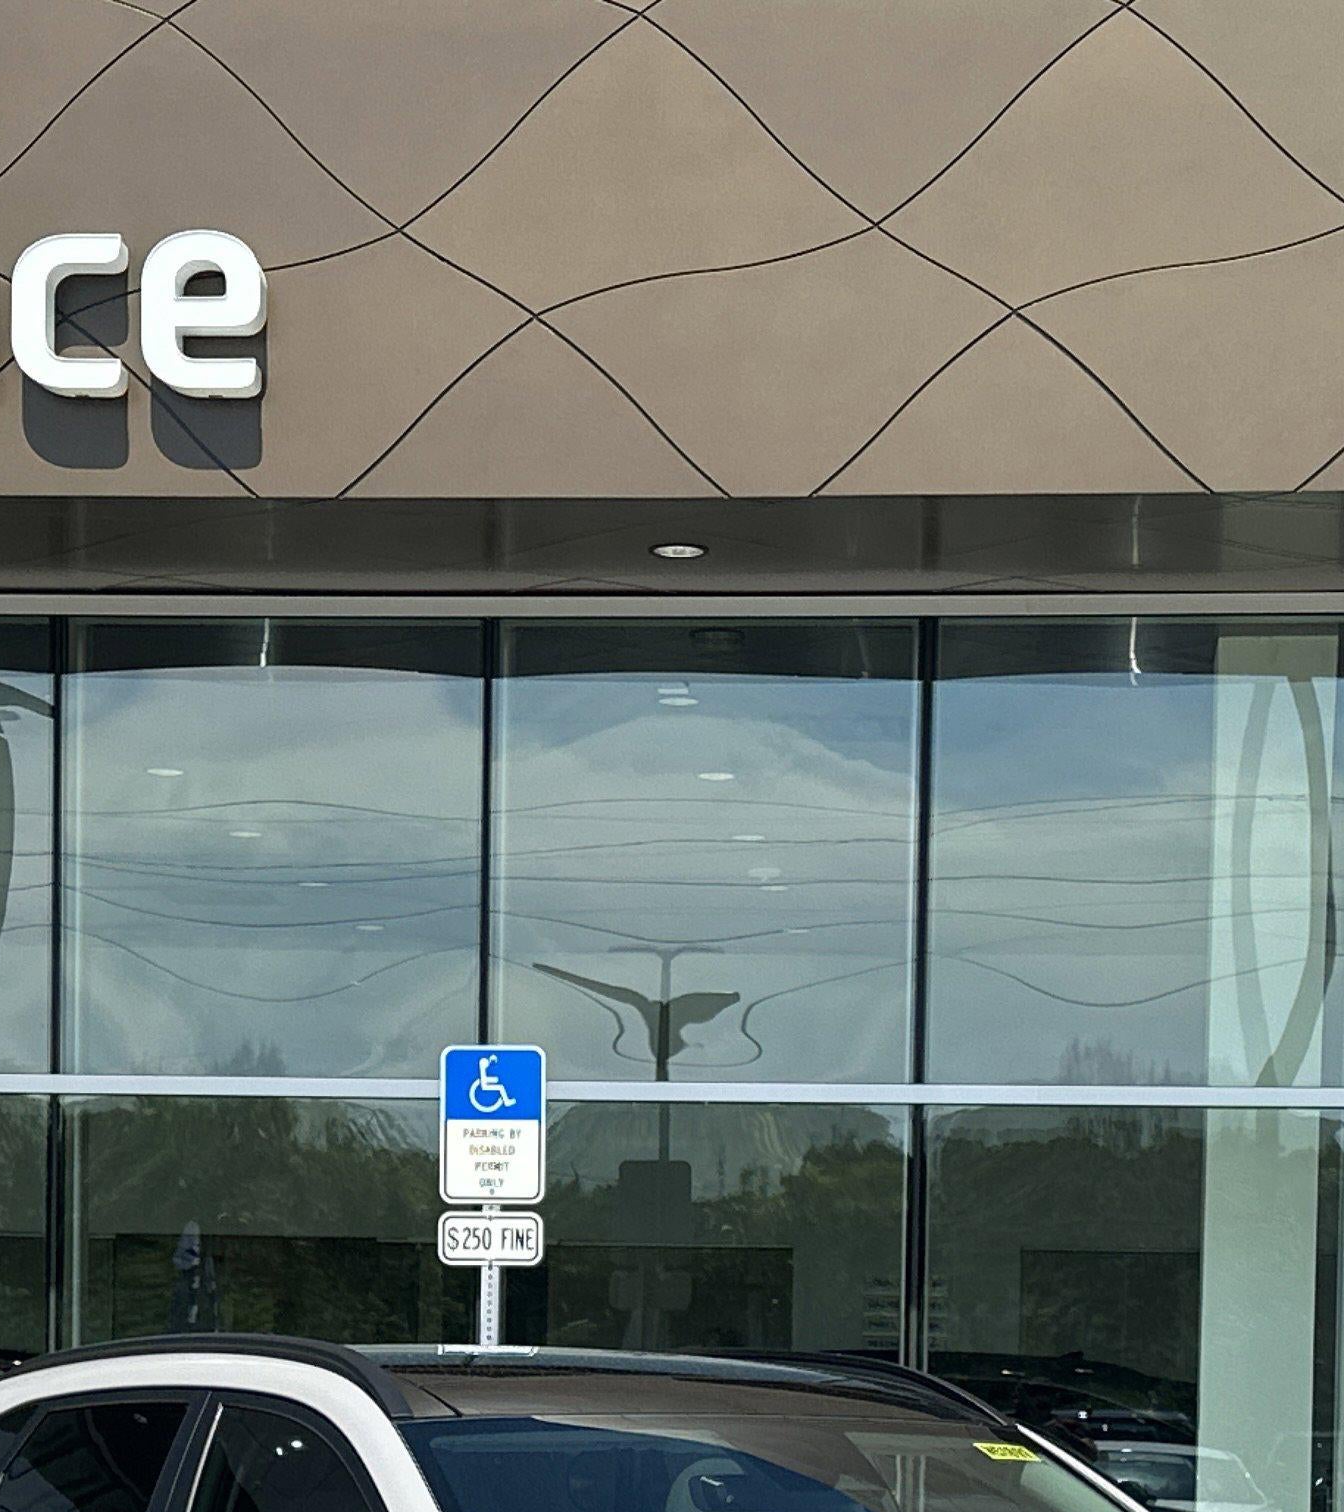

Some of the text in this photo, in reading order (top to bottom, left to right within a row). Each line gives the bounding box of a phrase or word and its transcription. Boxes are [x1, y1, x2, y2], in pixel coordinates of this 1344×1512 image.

[509, 1127, 522, 1139] BY
[447, 1226, 535, 1252] $250 FINE
